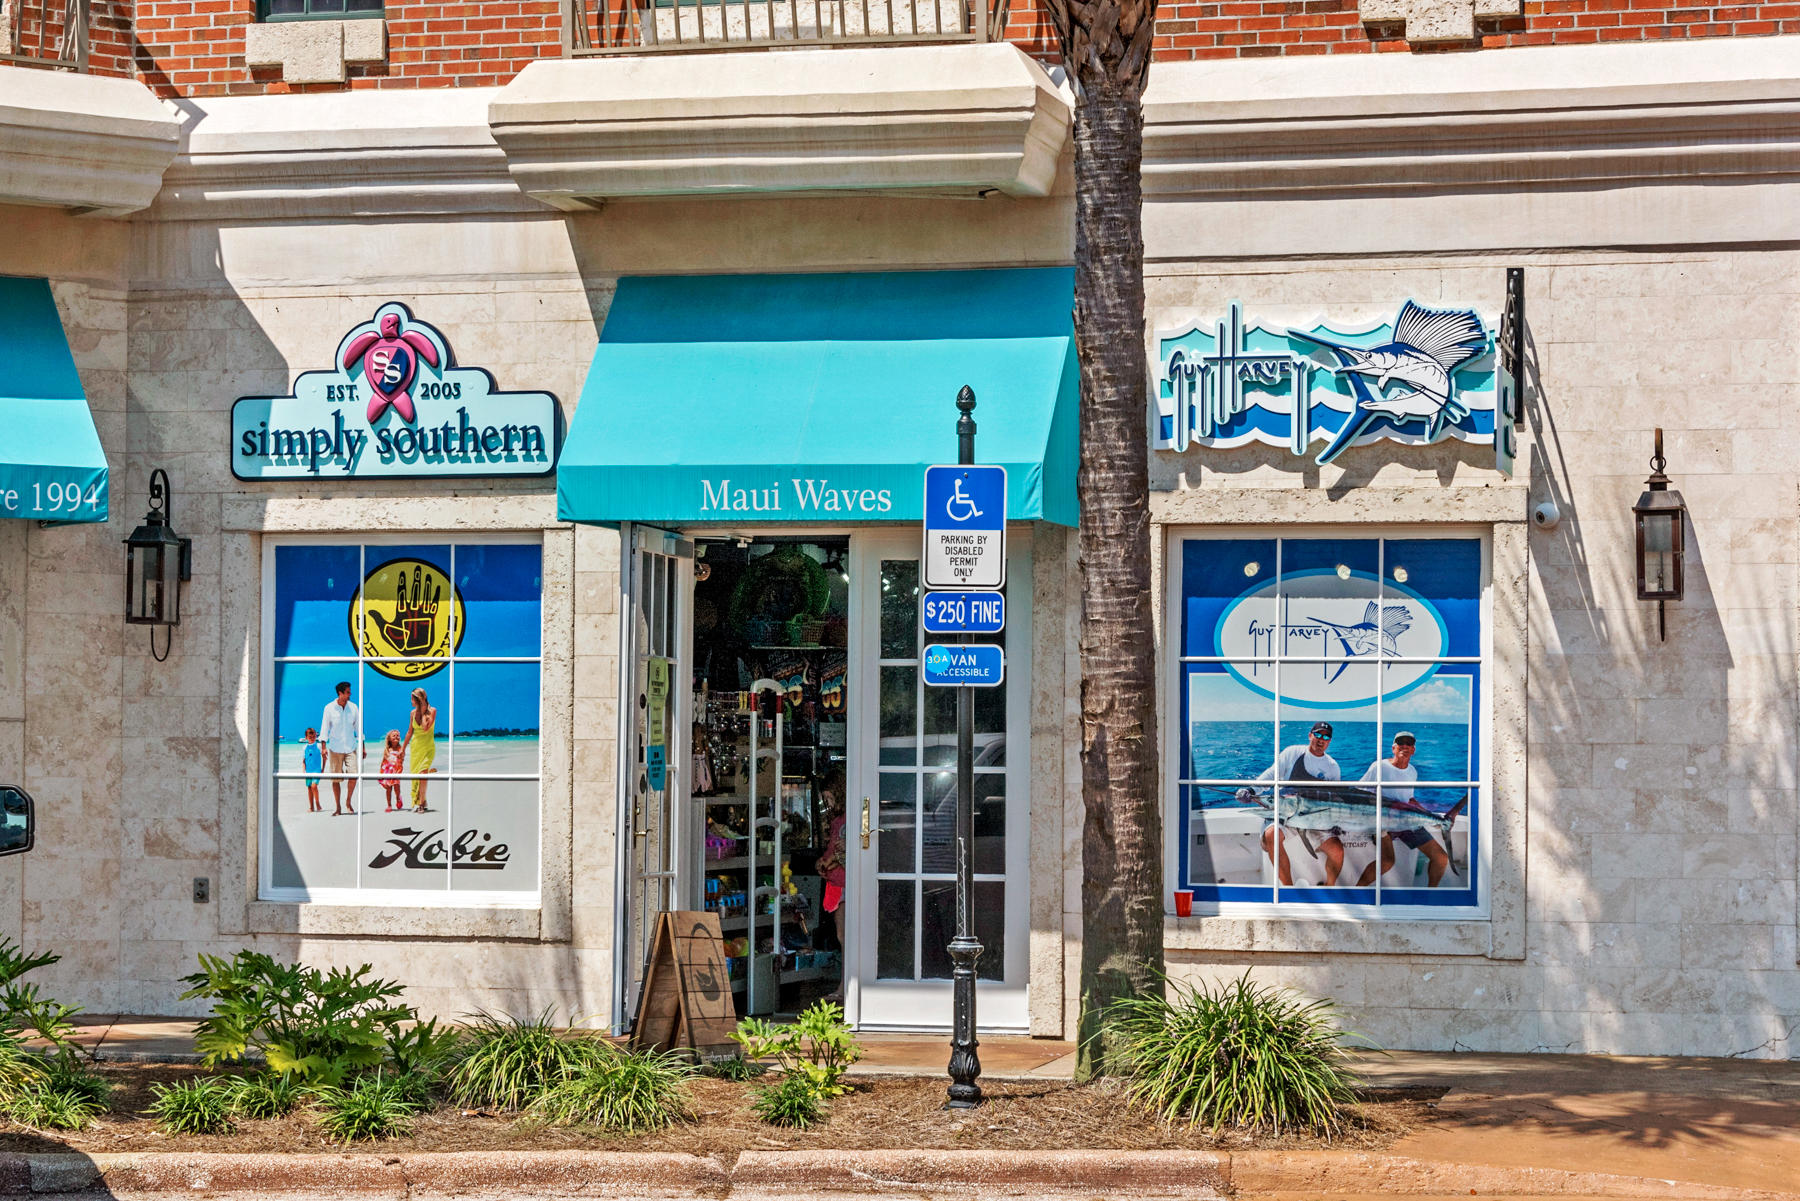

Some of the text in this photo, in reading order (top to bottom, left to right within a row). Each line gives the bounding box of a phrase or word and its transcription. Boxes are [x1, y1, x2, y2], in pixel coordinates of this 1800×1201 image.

[326, 382, 462, 401] EST. 2005
[241, 406, 546, 472] simply southern
[32, 482, 100, 512] 1994
[701, 478, 892, 512] Maui Waves
[940, 535, 988, 545] PARKING BY
[945, 546, 984, 556] DISABLED
[949, 557, 978, 566] PERMIT
[953, 567, 974, 577] ONLY
[926, 600, 1001, 624] $250 FINE
[950, 654, 977, 666] VAN
[368, 826, 511, 870] Hobie
[1343, 841, 1368, 849] UTCAST
